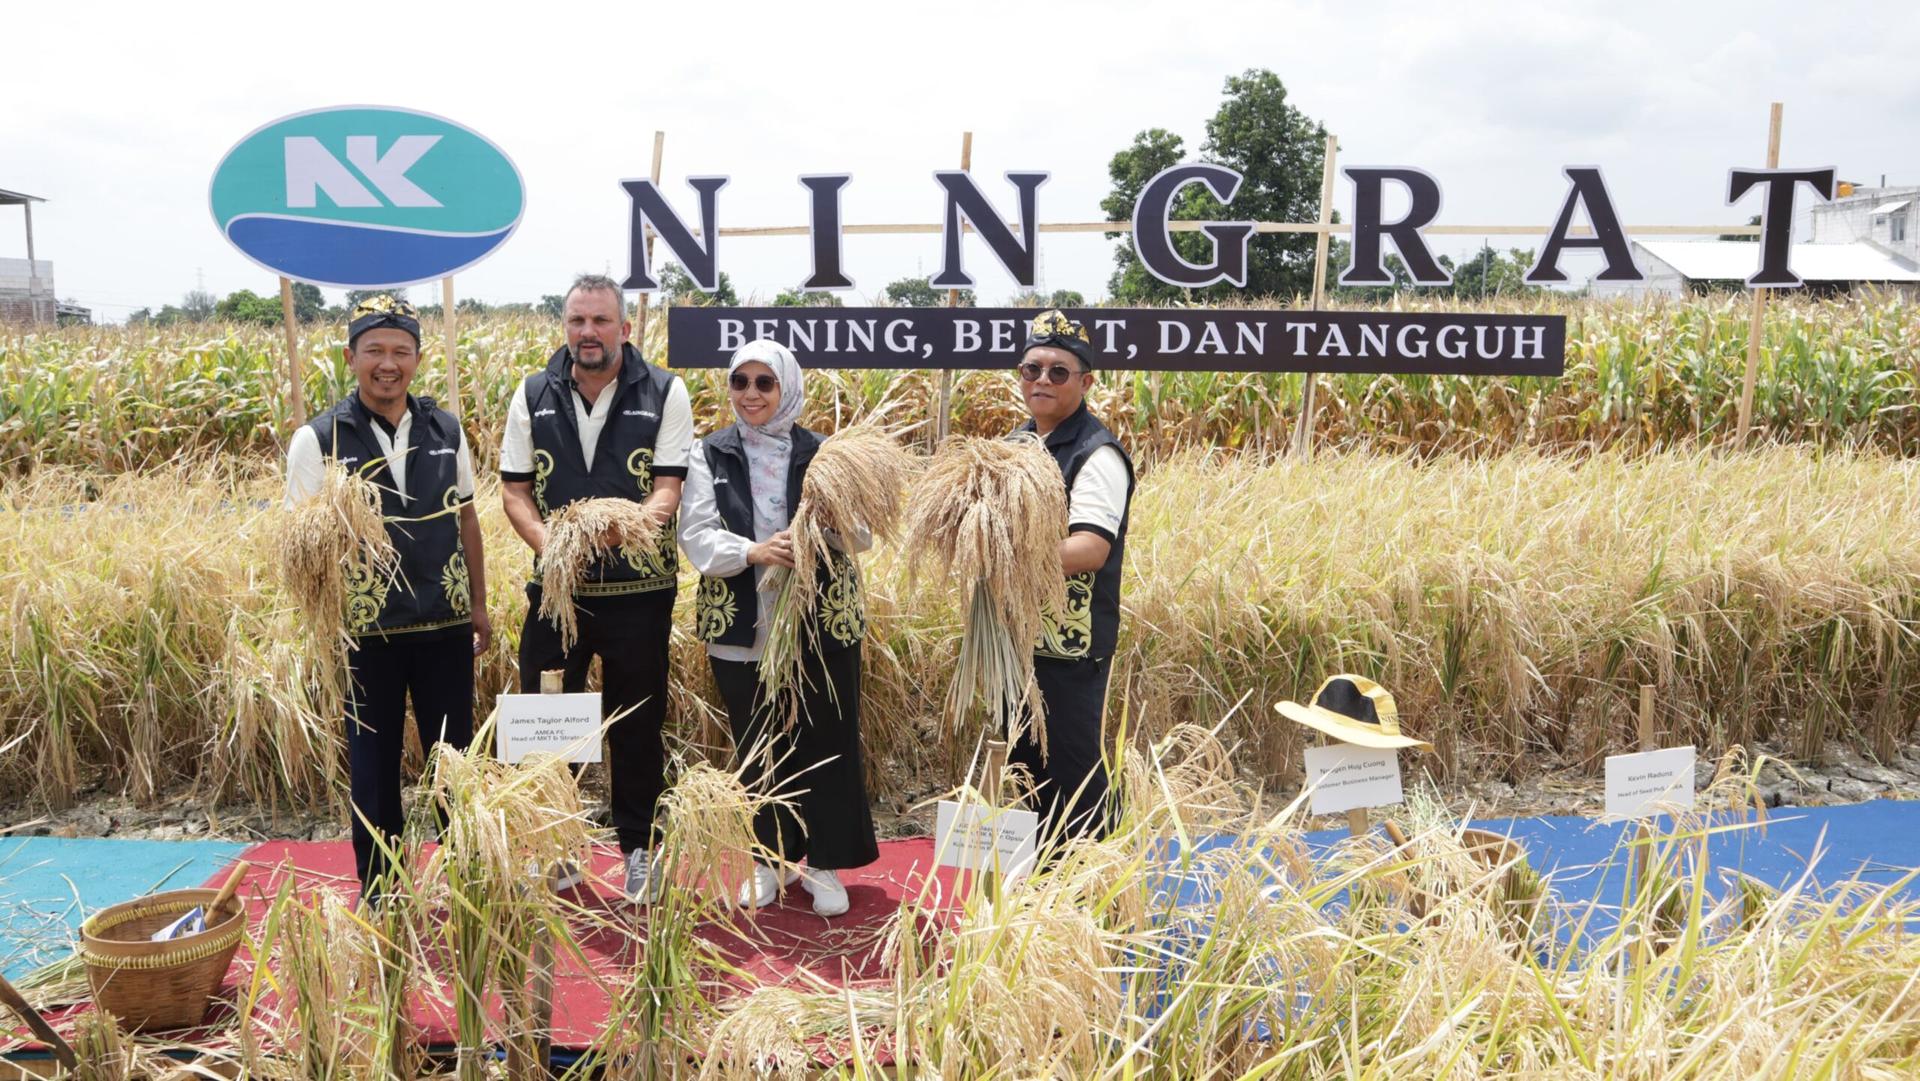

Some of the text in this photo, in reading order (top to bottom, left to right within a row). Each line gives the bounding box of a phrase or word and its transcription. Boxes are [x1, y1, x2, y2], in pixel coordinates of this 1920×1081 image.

[284, 134, 445, 208] NK
[619, 162, 1838, 292] NINGRAT
[953, 319, 1138, 359] BET,
[1157, 320, 1267, 355] DAN
[1286, 322, 1547, 359] TANGGUH
[510, 717, 535, 725] James
[537, 717, 562, 725] Taylor
[1348, 763, 1362, 771] Huy
[1363, 760, 1386, 769] Cuong
[1343, 777, 1368, 785] Business
[1628, 774, 1646, 782] Kevin
